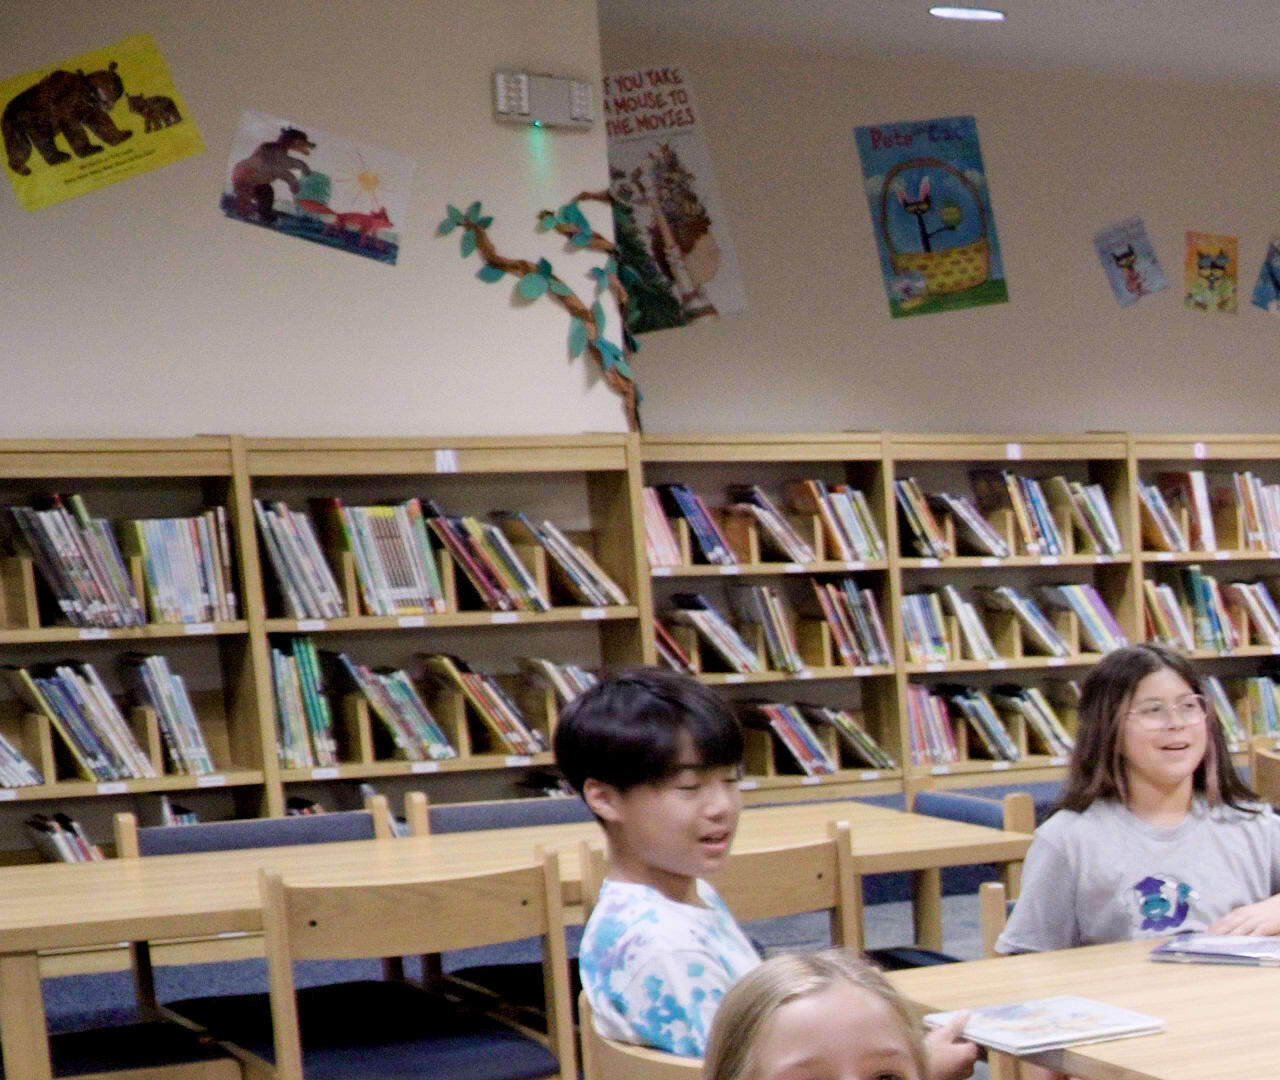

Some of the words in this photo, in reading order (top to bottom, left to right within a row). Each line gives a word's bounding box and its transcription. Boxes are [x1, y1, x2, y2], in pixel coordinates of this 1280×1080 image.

[615, 72, 643, 92] YOU
[646, 68, 682, 87] TAKE
[613, 91, 667, 115] MOUSE
[668, 90, 688, 106] TO
[635, 107, 695, 132] MOVIES
